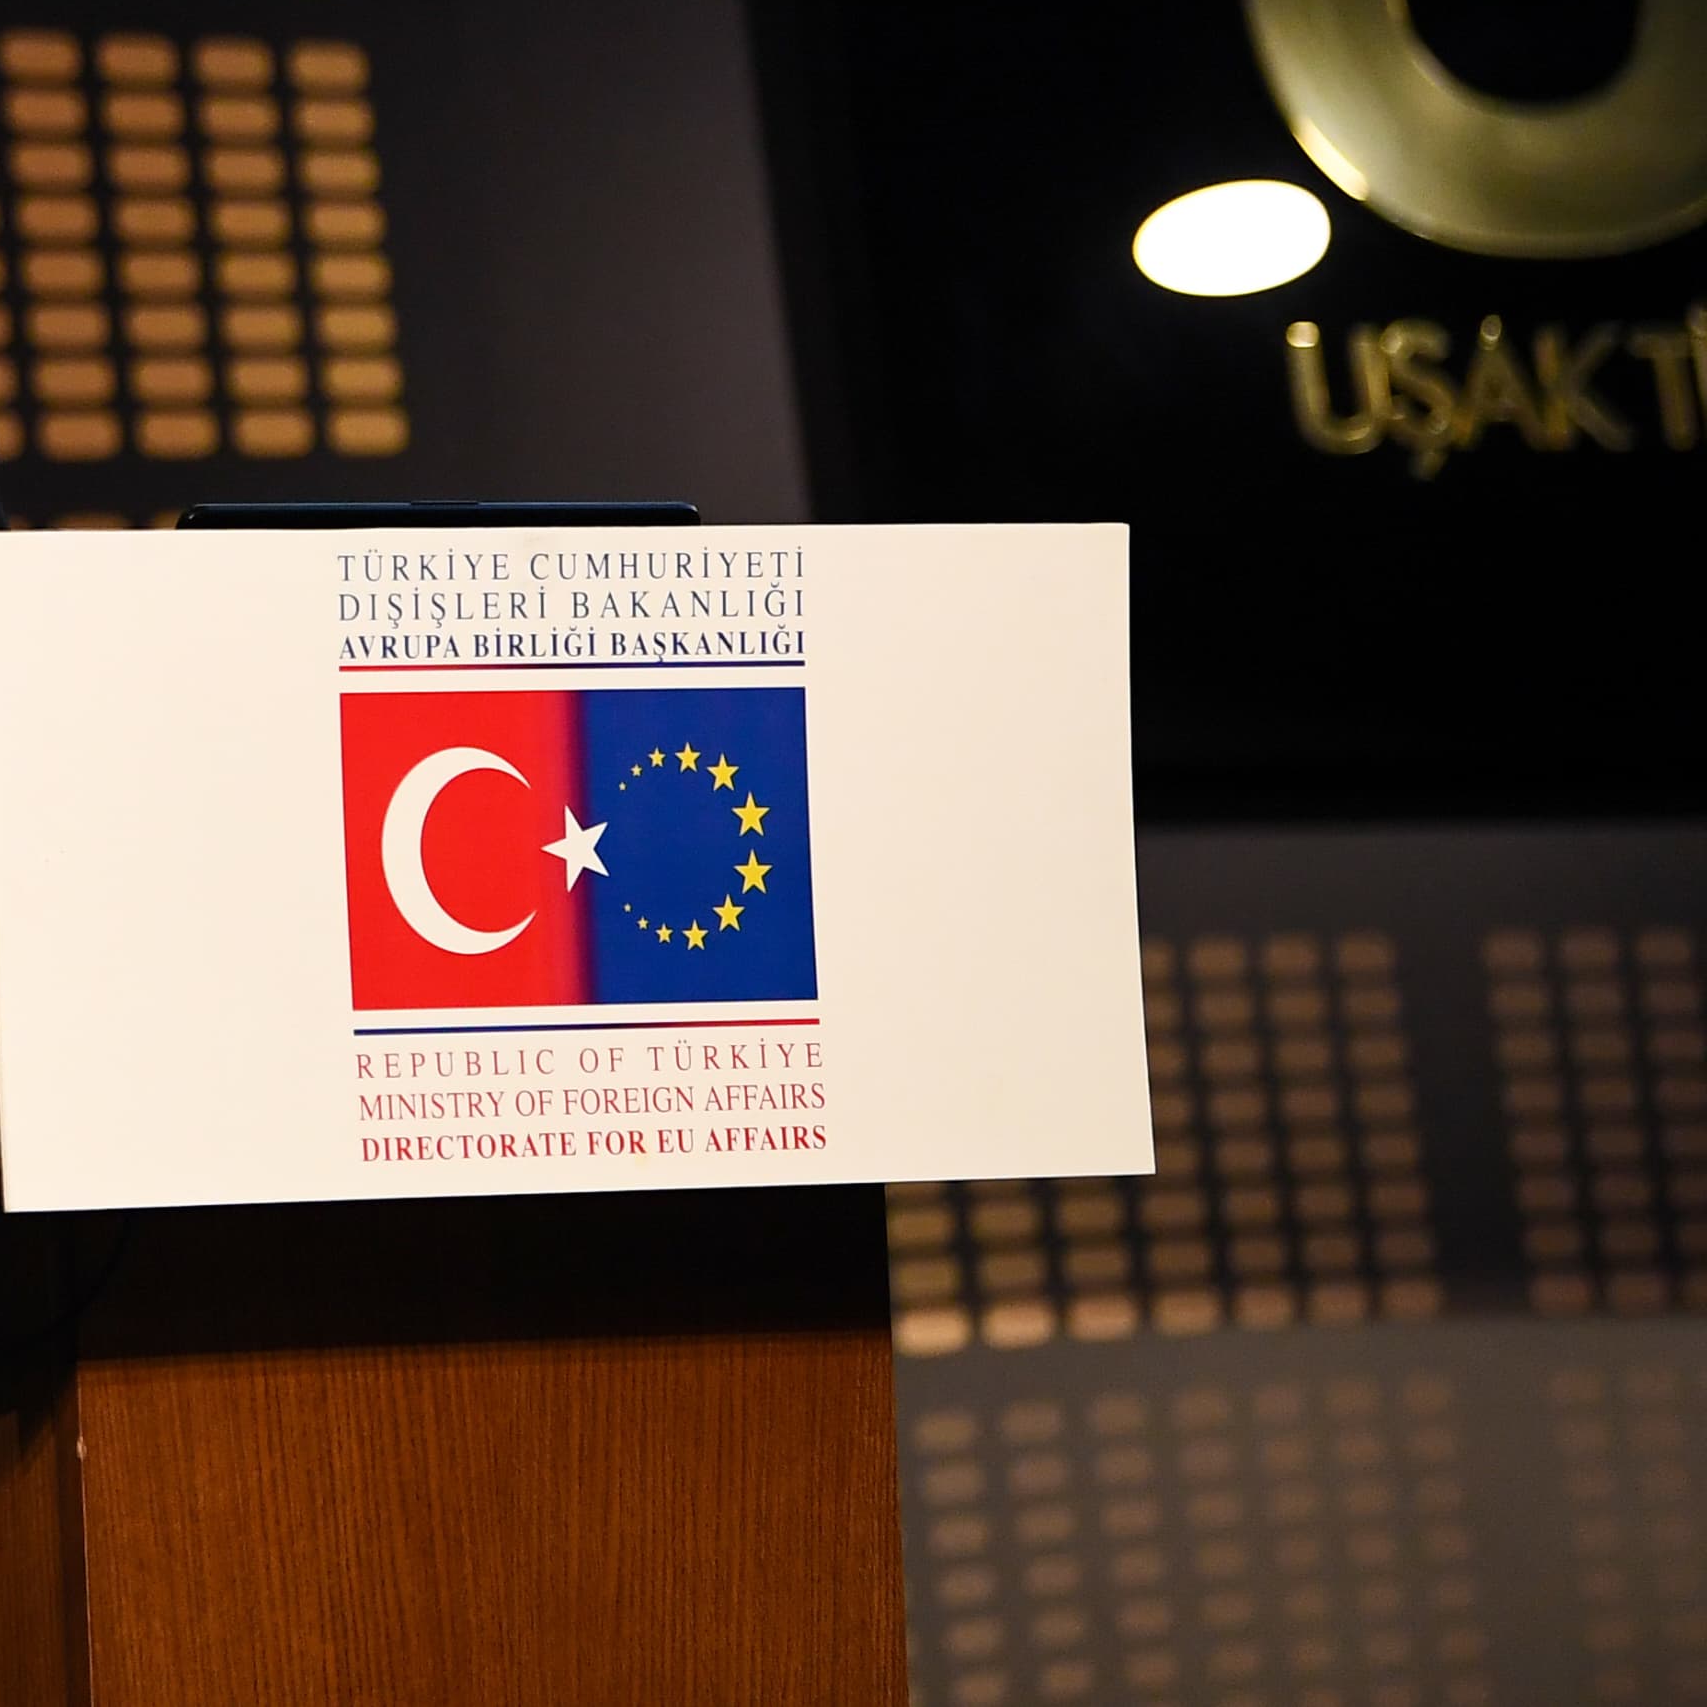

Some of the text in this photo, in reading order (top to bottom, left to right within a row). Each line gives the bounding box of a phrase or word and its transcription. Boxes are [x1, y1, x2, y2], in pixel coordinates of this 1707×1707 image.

[337, 545, 804, 582] TÜRKİYE CUMHURİYETİ
[338, 581, 804, 629] DIŞİŞLERİ BAKANLIĞI
[339, 623, 805, 662] AVRUPA BİRLİĞİ BAŞKANLIĞI
[356, 1037, 823, 1079] REPUBLIC OF TÜRKİYE
[359, 1082, 826, 1121] MINISTRY OF FOREIGN AFFAIRS
[361, 1124, 827, 1162] DIRECTORATE FOR EU AFFAIRS
